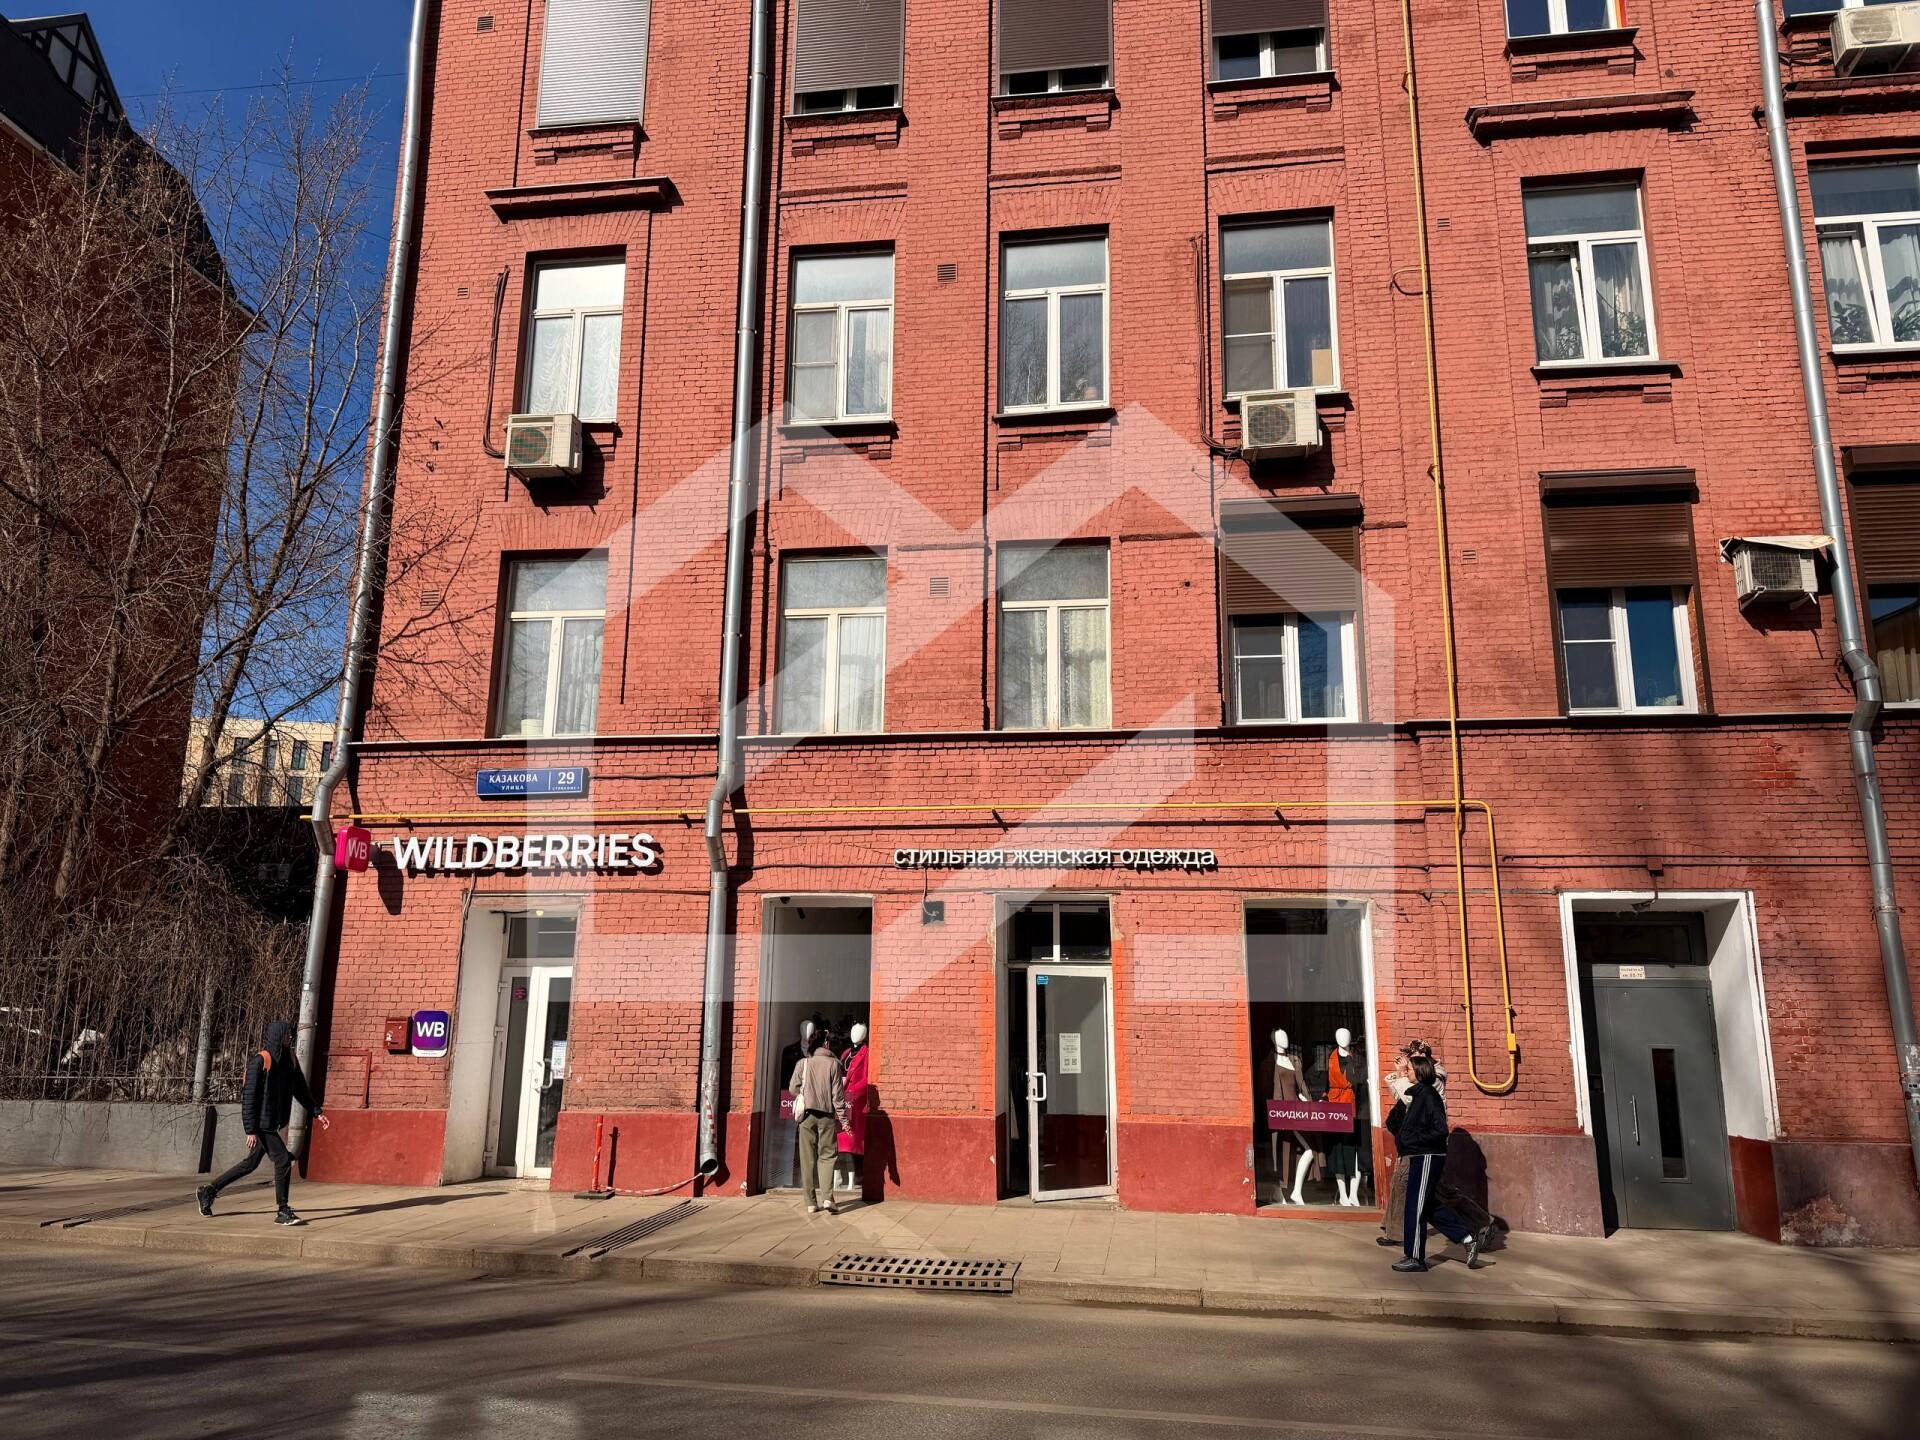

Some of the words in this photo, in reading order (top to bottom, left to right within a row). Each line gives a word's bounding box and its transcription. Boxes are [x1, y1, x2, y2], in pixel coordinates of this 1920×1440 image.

[488, 773, 538, 784] КАЗАКОВА
[557, 771, 576, 785] 29
[348, 838, 368, 860] WB
[393, 833, 657, 870] WILDBERRIES
[894, 848, 1004, 865] стильная
[1011, 848, 1111, 865] женская
[1120, 848, 1216, 868] одежда
[416, 1021, 445, 1038] WB
[1268, 1109, 1309, 1120] СКИДКИ
[1310, 1111, 1326, 1121] ДО
[1328, 1112, 1349, 1121] 70%
